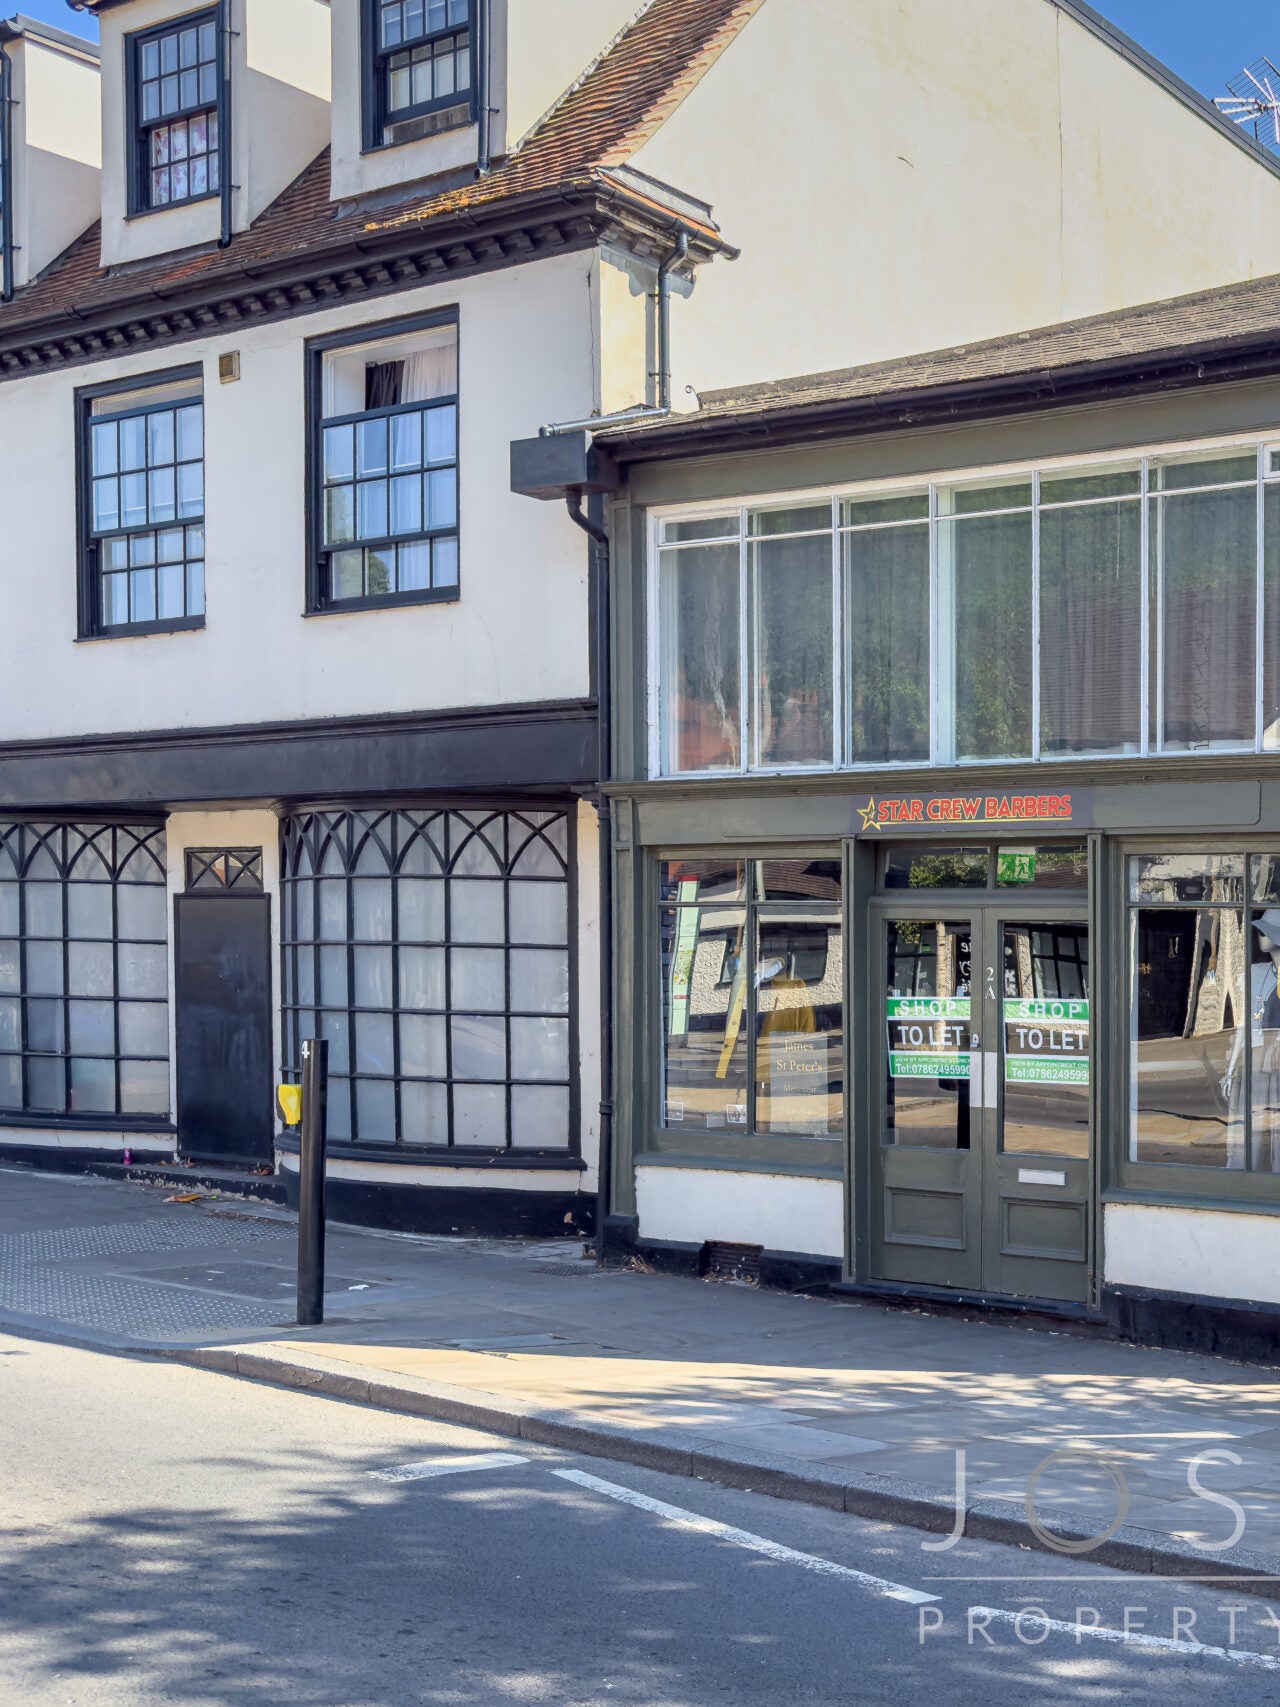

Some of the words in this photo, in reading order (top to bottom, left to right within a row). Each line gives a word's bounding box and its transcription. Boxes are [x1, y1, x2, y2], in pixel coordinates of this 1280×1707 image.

[877, 799, 923, 821] STAR
[926, 797, 982, 820] CREW
[985, 795, 1073, 818] BARBERS
[899, 1000, 957, 1017] SHOP
[1018, 1002, 1081, 1019] SHOP
[897, 1026, 924, 1046] TO
[929, 1026, 965, 1047] LET
[1015, 1028, 1043, 1050] TO
[1049, 1030, 1086, 1050] LET
[302, 1040, 310, 1058] 4
[783, 1039, 814, 1053] James
[776, 1059, 786, 1071] St
[789, 1060, 823, 1072] Peter's
[1011, 1067, 1089, 1080] Tel:0786249599
